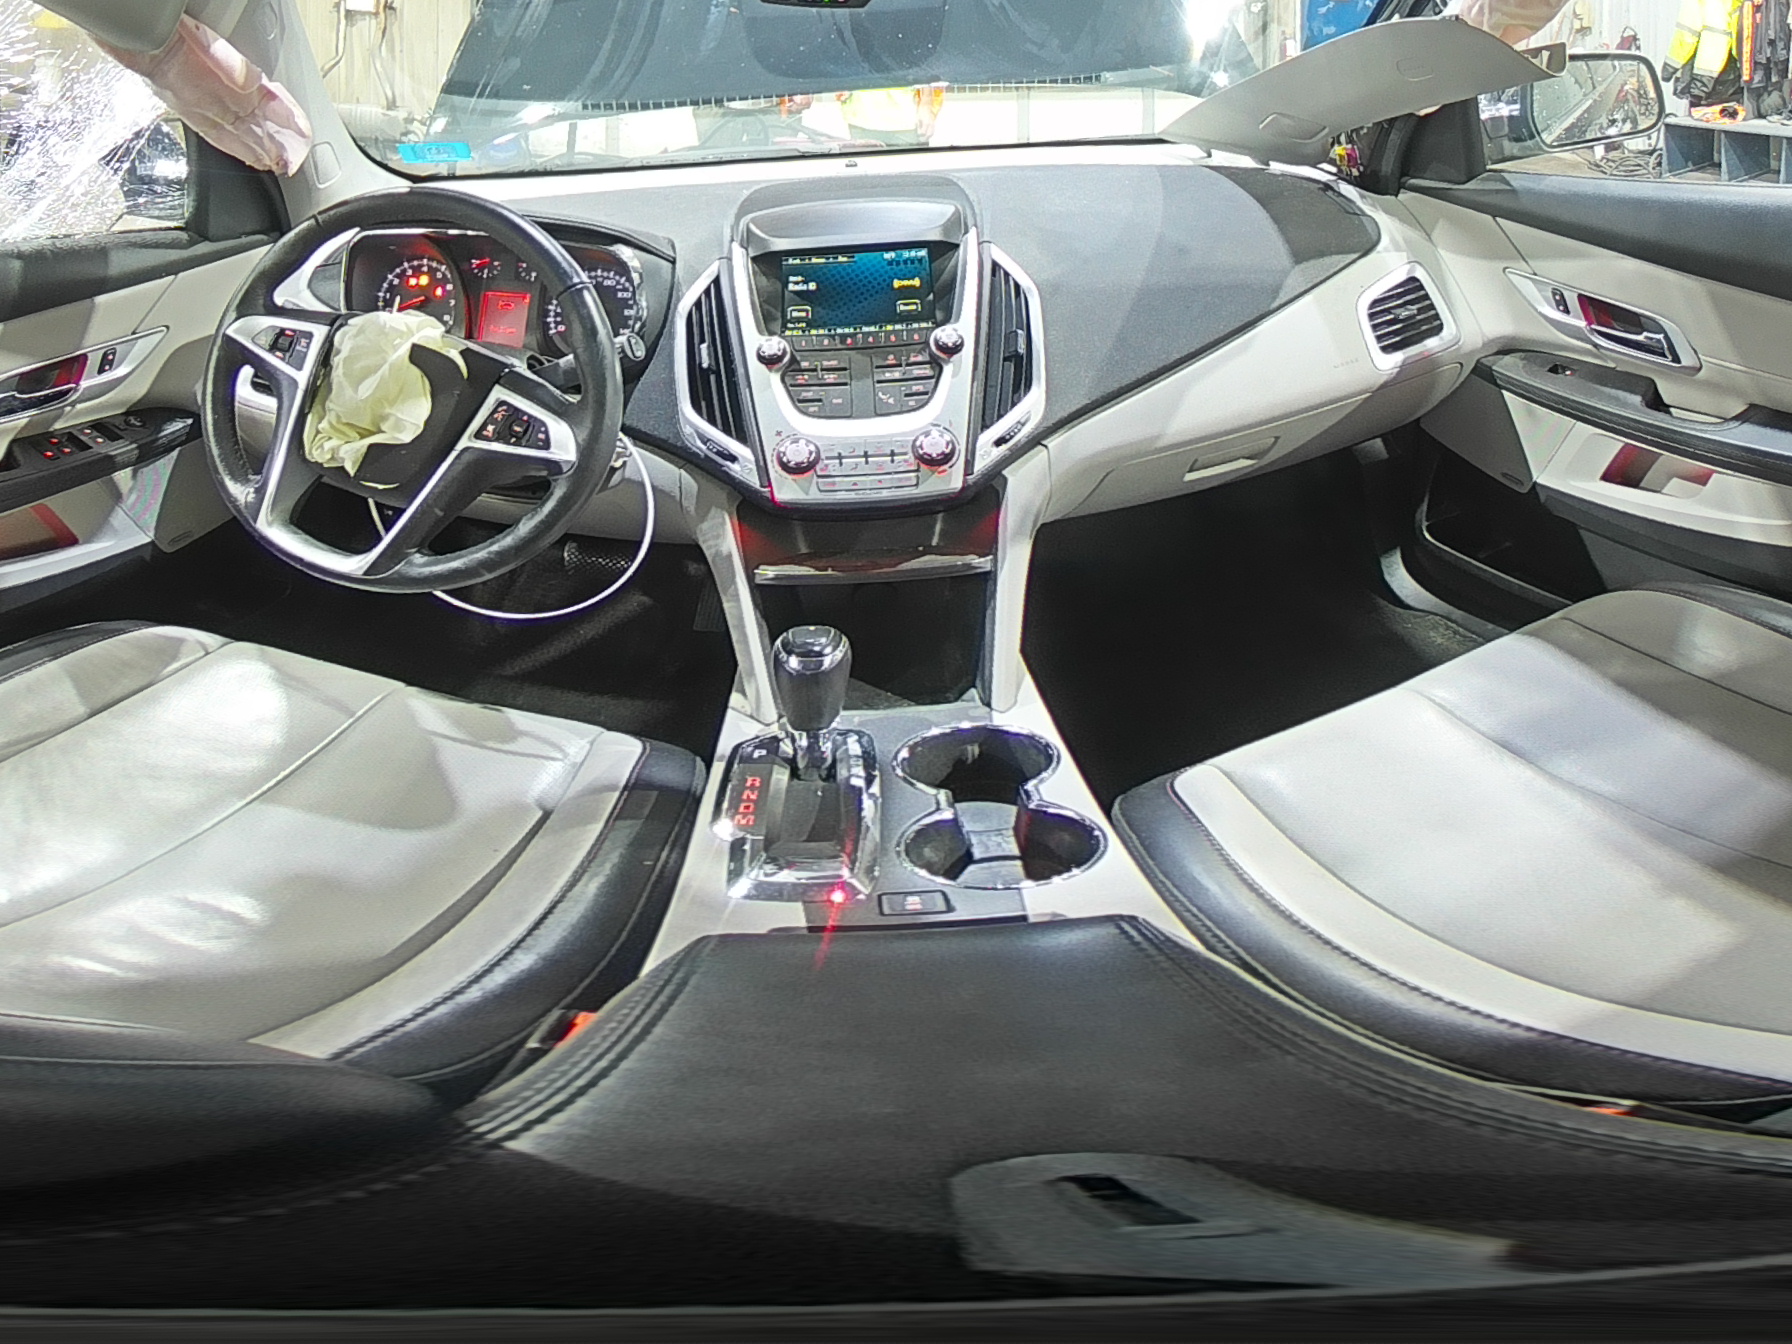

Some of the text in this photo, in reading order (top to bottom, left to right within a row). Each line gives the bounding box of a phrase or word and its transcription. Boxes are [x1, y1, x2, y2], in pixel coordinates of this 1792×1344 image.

[753, 749, 767, 759] P
[745, 776, 761, 787] R
[741, 789, 758, 800] N
[738, 802, 755, 813] D
[734, 814, 755, 825] M
